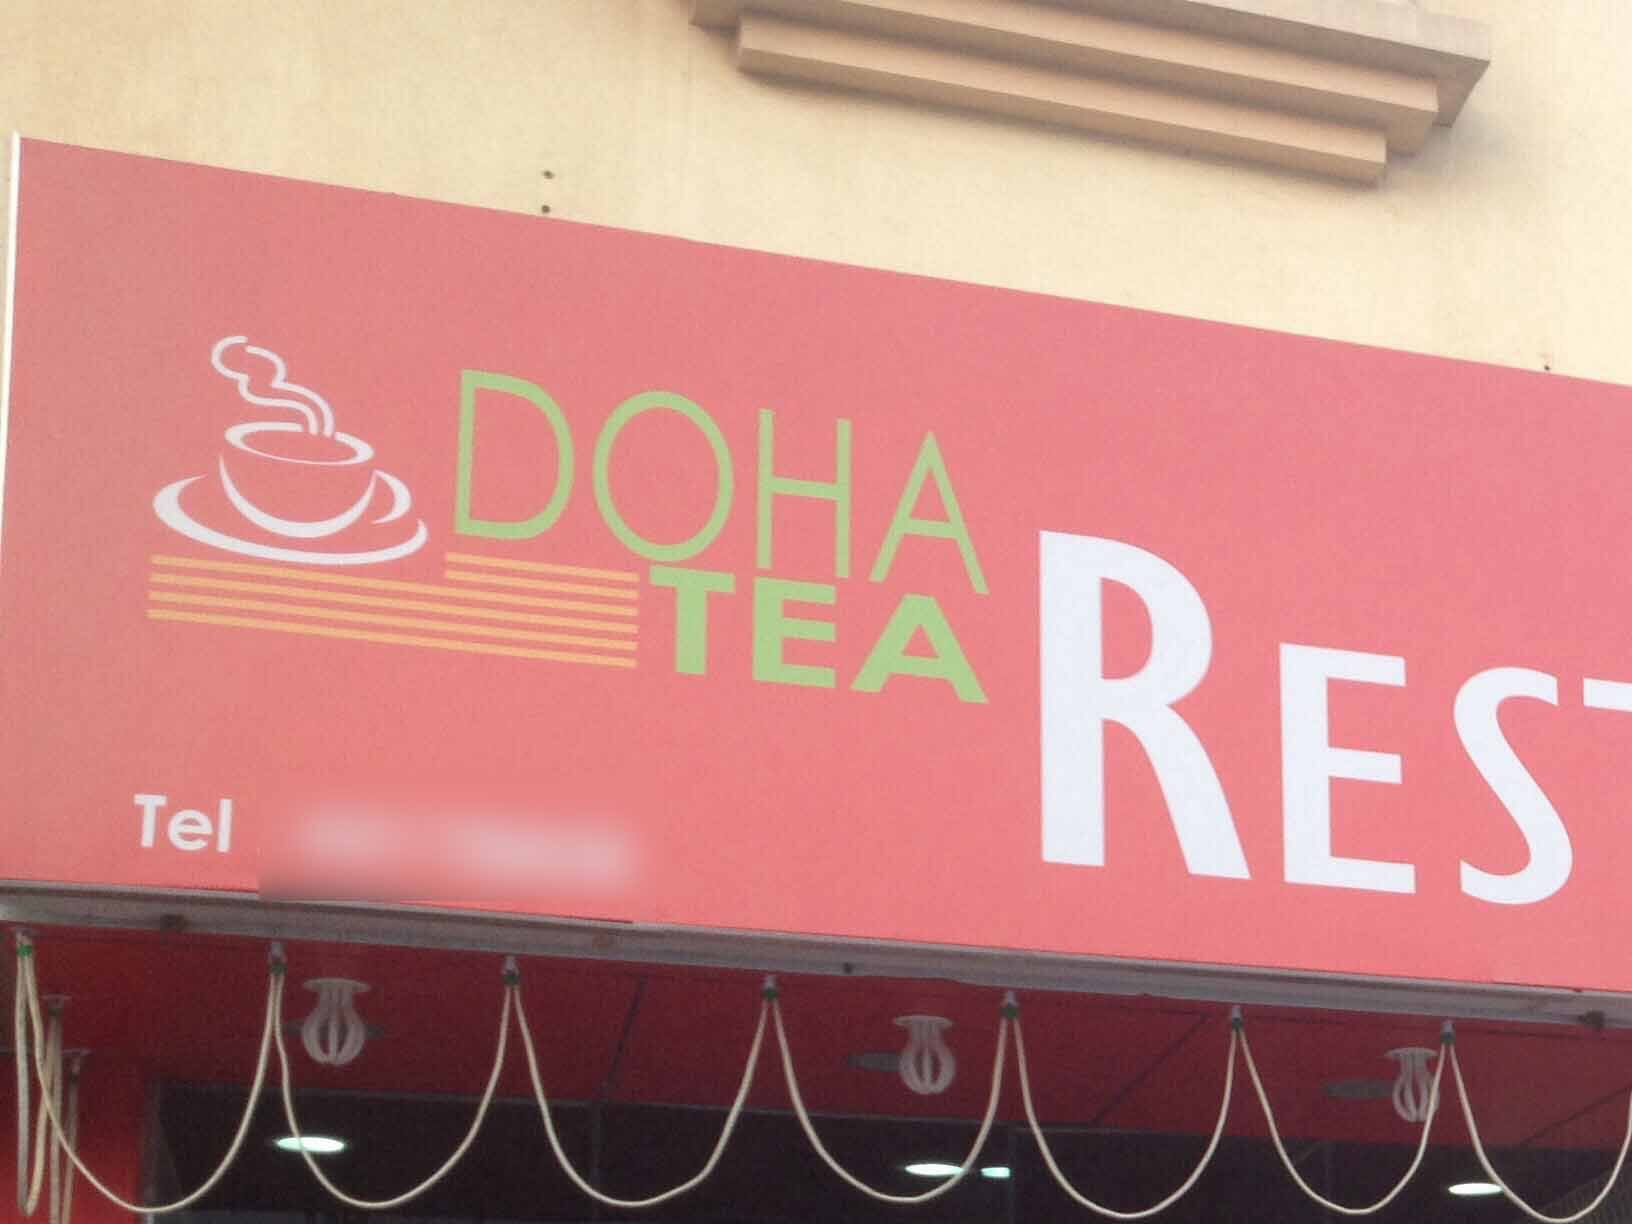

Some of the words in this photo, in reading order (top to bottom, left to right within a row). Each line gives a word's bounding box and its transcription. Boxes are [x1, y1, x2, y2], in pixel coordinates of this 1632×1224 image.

[453, 369, 989, 595] DOHA
[648, 564, 989, 704] TEA
[133, 793, 234, 853] Tel
